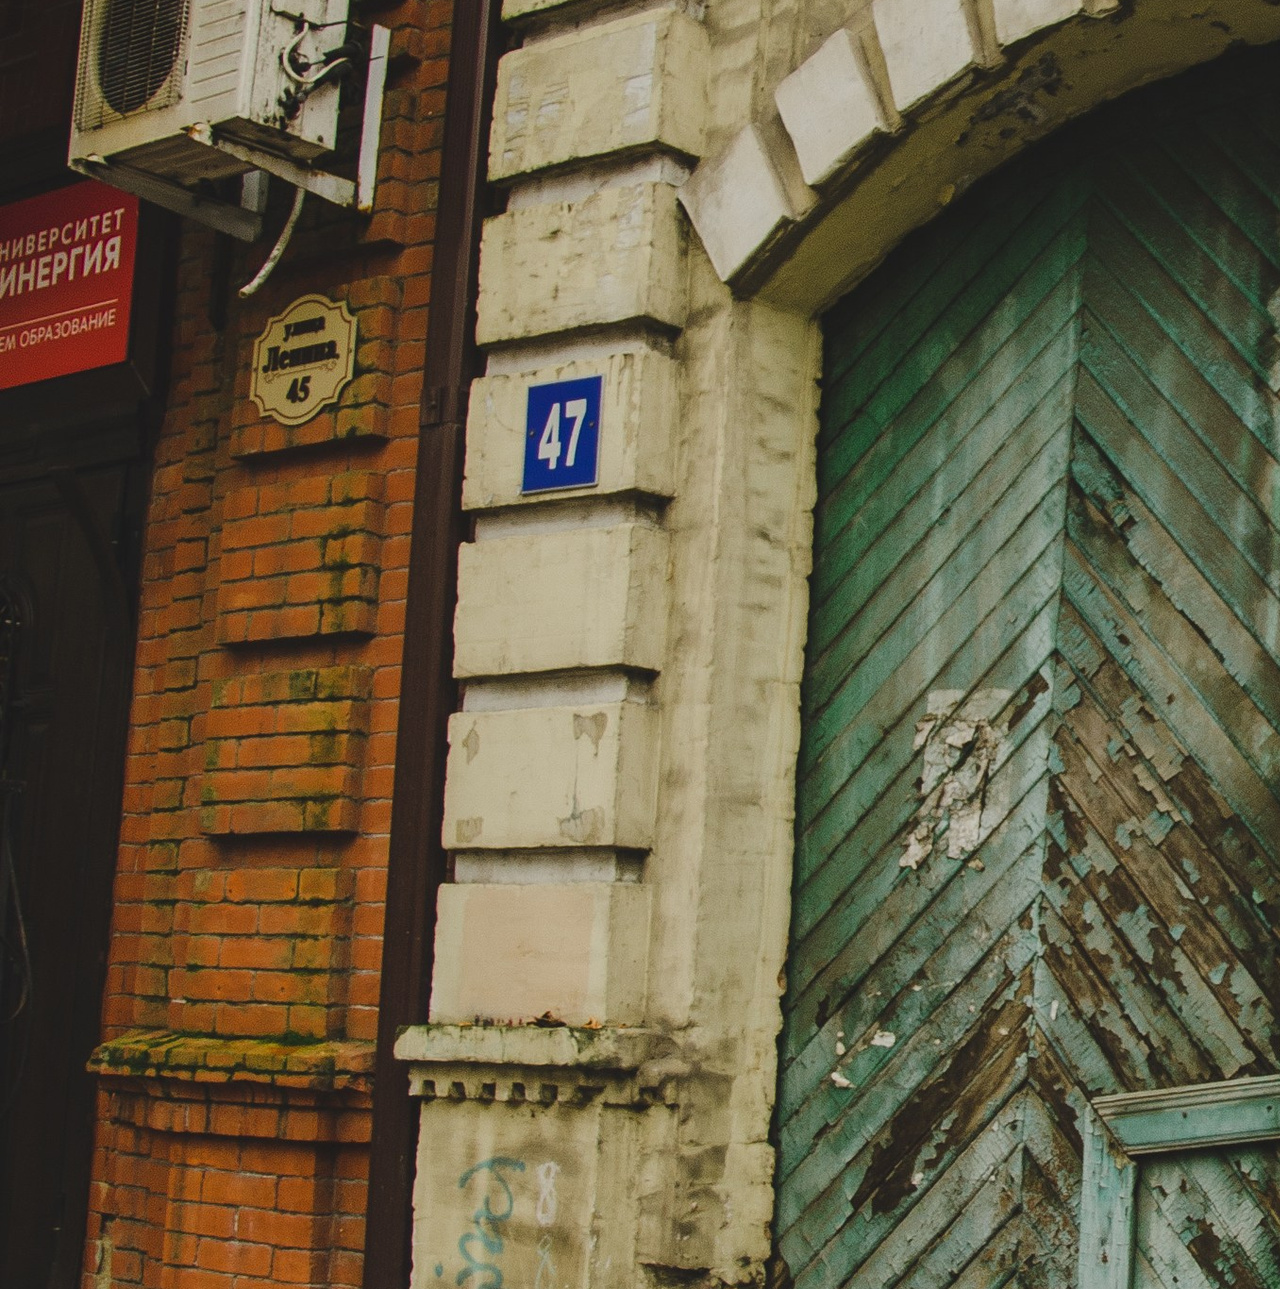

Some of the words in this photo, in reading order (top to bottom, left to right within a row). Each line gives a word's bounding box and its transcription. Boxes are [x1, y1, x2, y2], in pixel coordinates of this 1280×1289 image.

[19, 308, 117, 349] ОБРАЗОВАНИЕ
[286, 375, 312, 404] 45
[537, 398, 588, 470] 47
